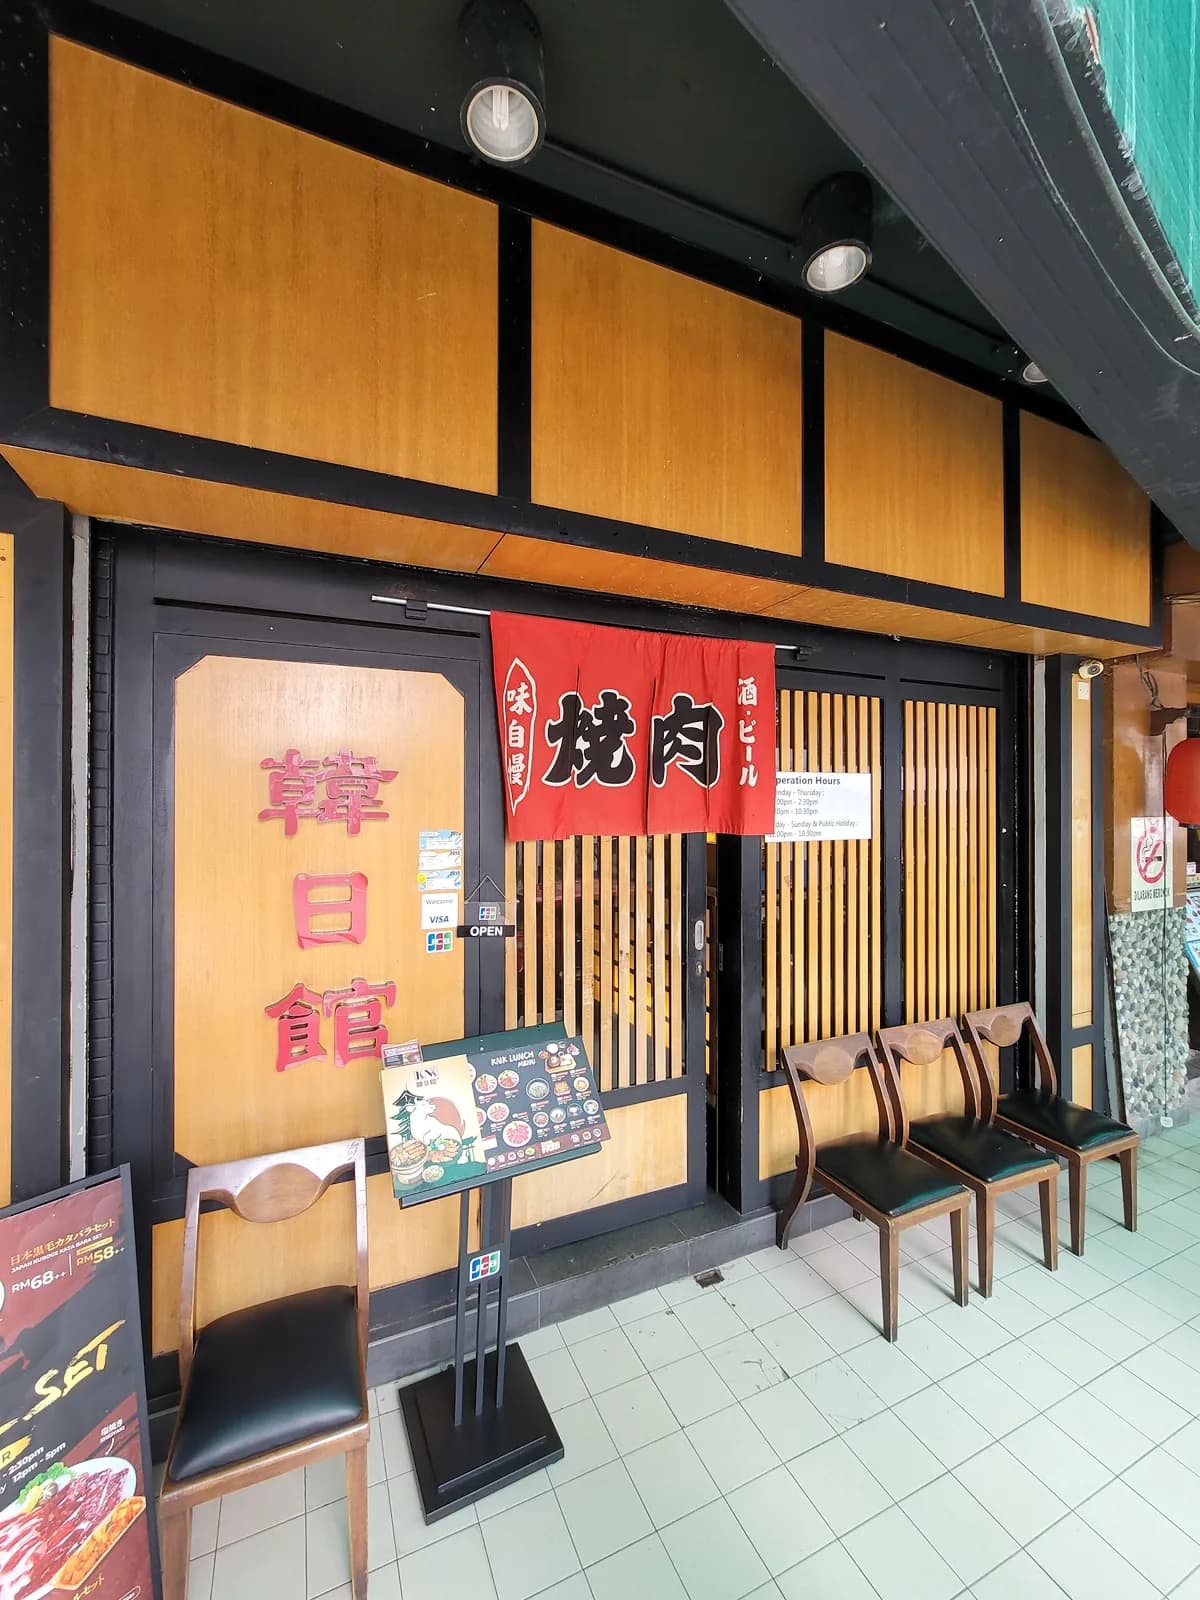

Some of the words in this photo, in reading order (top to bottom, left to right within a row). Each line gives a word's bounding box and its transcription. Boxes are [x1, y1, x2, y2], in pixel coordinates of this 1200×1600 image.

[507, 682, 533, 787] 味自慢
[541, 689, 724, 788] 焼肉
[738, 676, 758, 787] 酒・ビール
[776, 776, 813, 786] peration
[816, 777, 841, 785] Hours
[792, 821, 812, 829] Sunday
[429, 916, 449, 924] VISA
[470, 926, 503, 937] OPEN
[427, 932, 453, 952] JCB
[509, 1051, 534, 1062] LUNCH
[471, 1252, 500, 1280] JCB
[23, 1319, 126, 1421] SET
[8, 1446, 45, 1475] 2:30pm
[13, 1462, 38, 1483] 12pm
[45, 1442, 67, 1461] 5pm
